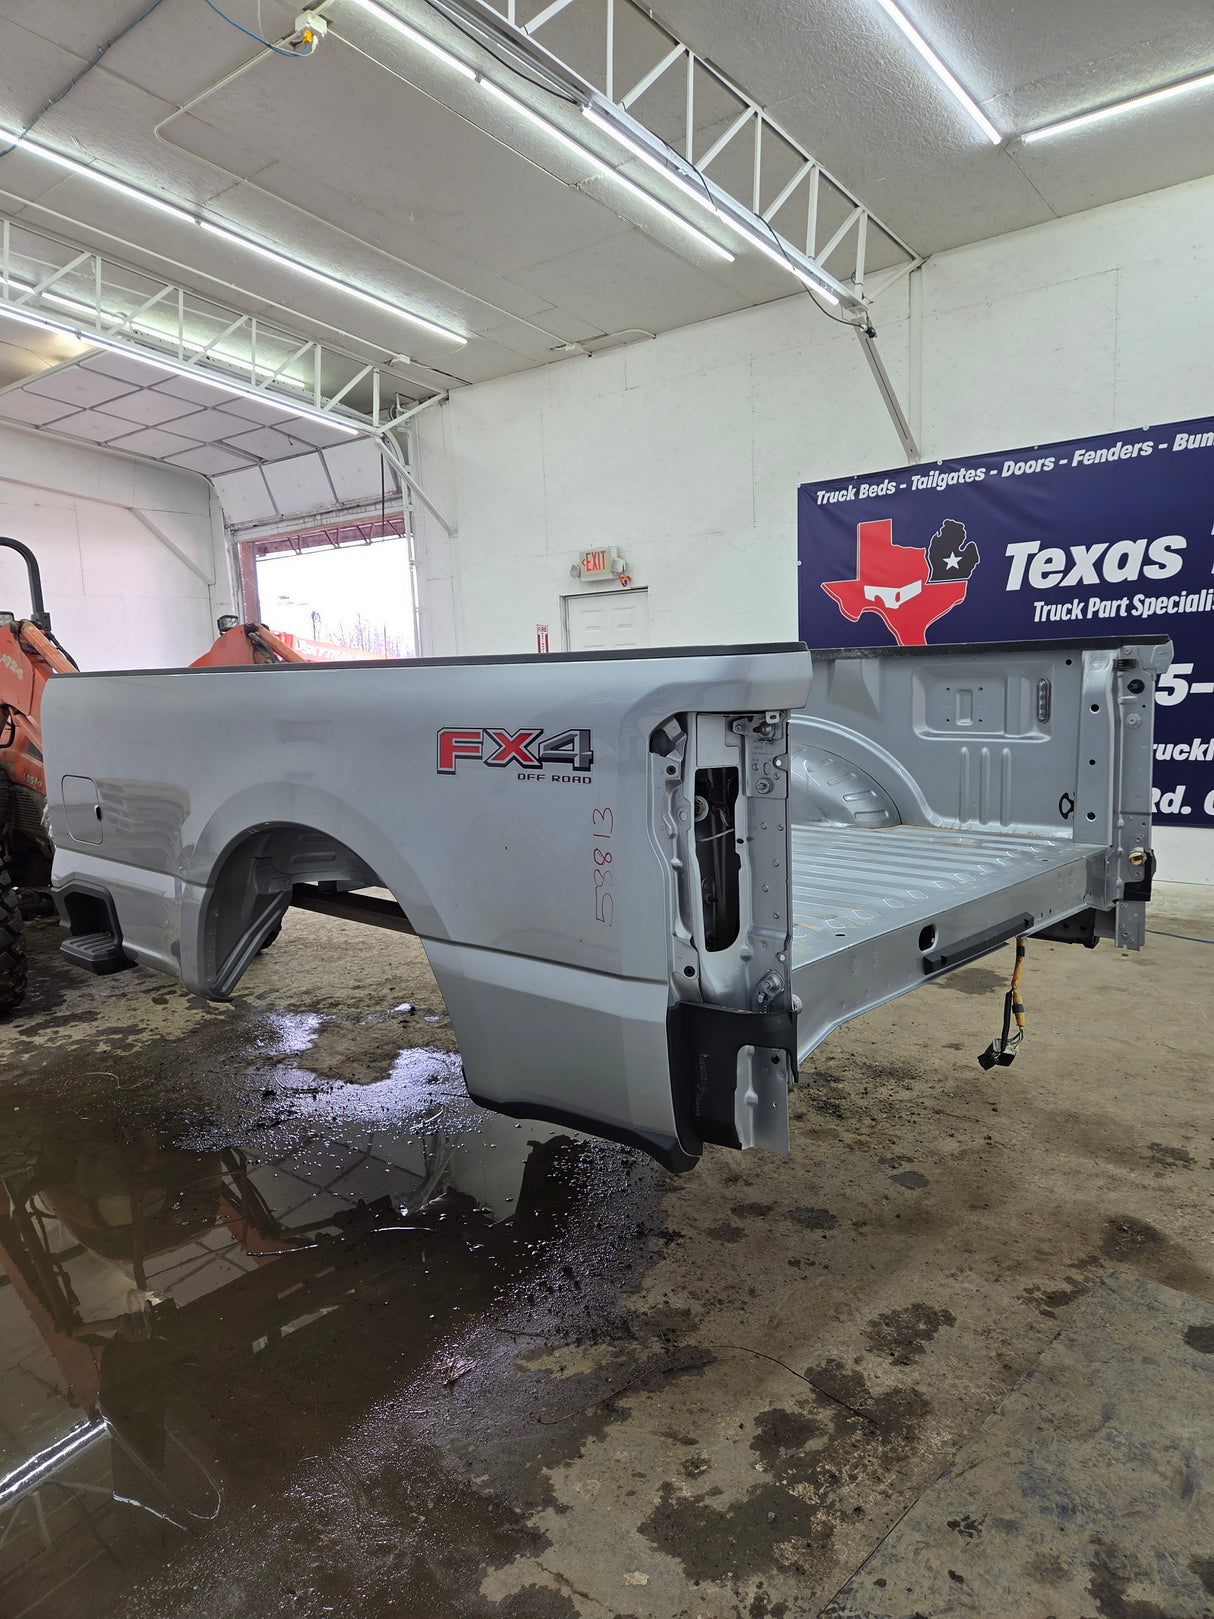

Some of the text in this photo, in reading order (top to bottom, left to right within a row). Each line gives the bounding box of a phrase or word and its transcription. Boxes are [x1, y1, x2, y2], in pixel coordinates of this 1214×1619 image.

[817, 482, 857, 505] Truck
[859, 475, 897, 499] Beds
[911, 466, 987, 495] Tailgates
[1001, 456, 1055, 477] Doors
[1071, 441, 1154, 467] Fenders
[585, 550, 606, 572] EXIT
[1005, 534, 1187, 591] Texas
[1033, 588, 1214, 622] Truck Part Speciali
[437, 727, 593, 775] FX4
[517, 773, 592, 784] OFF ROAD
[592, 807, 613, 927] 58813
